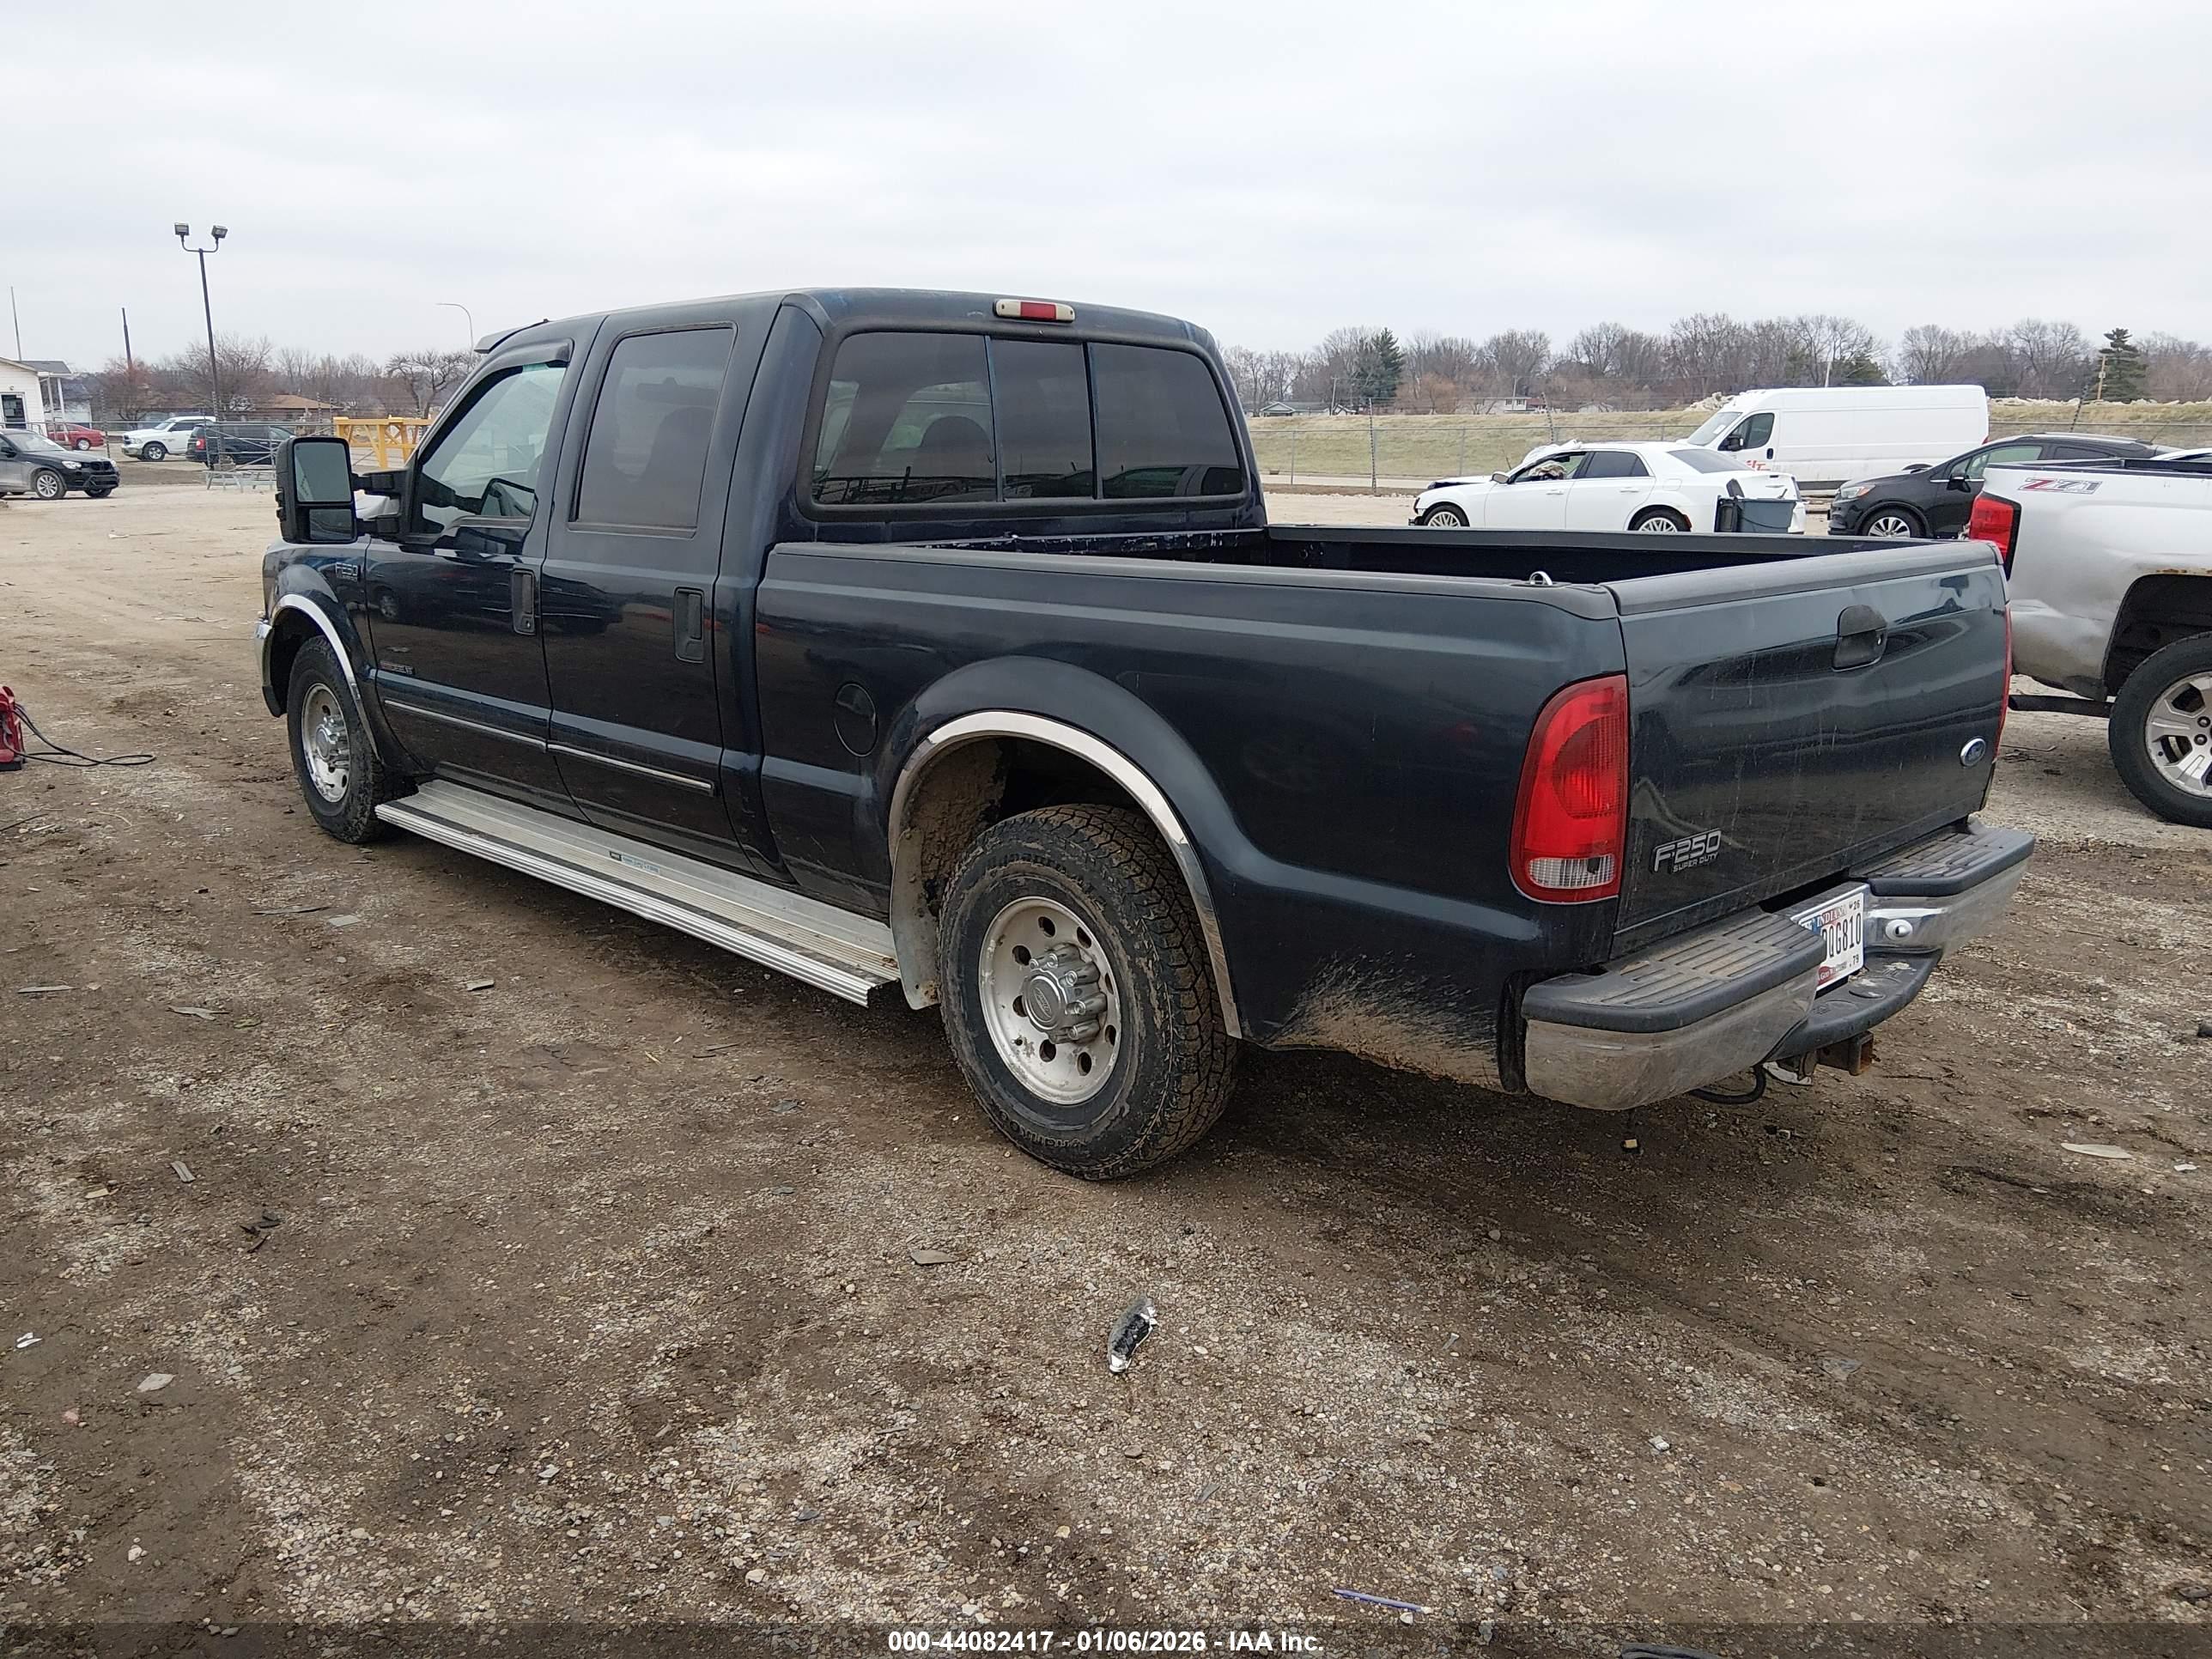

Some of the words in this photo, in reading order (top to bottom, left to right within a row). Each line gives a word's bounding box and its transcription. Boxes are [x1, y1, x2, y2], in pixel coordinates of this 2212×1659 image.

[2018, 477, 2102, 495] Z71
[1673, 859, 1698, 872] SUPER
[1699, 852, 1718, 864] DUTY
